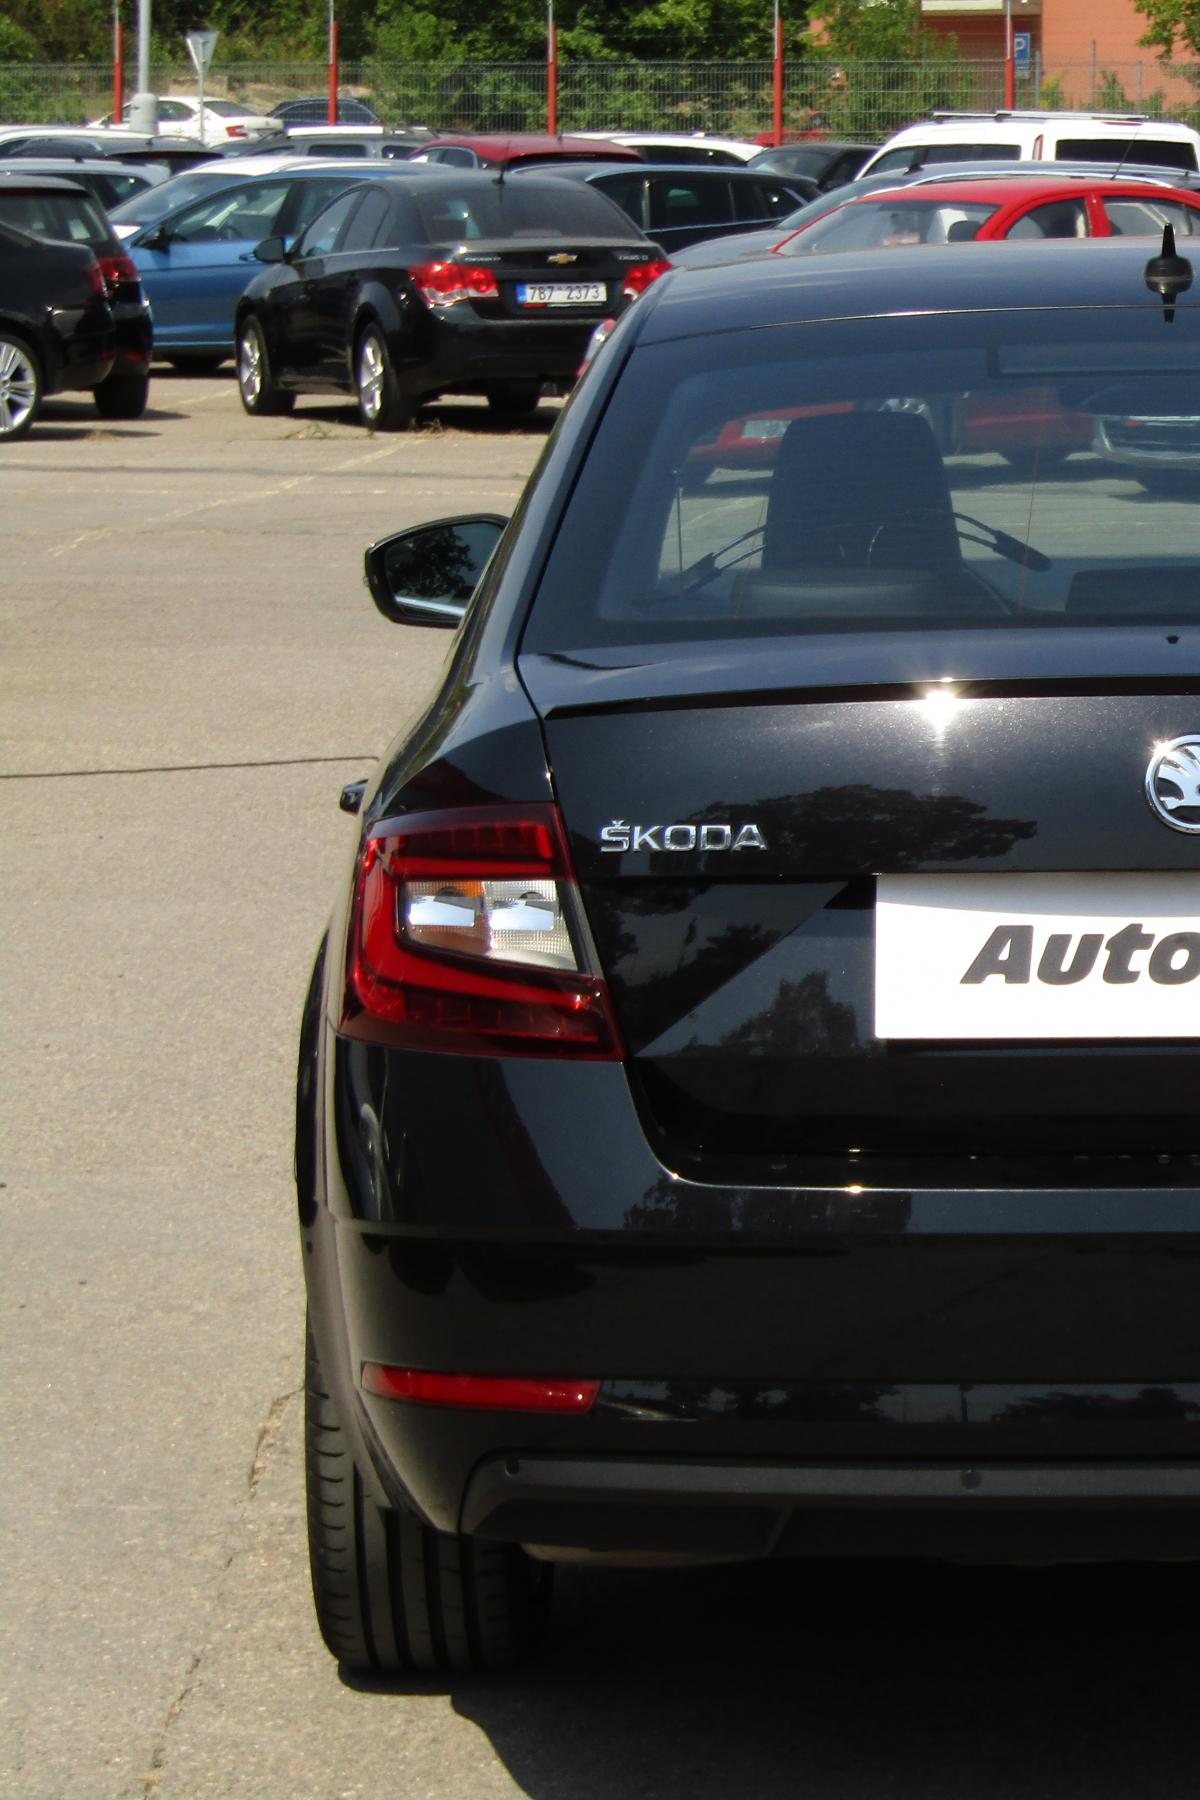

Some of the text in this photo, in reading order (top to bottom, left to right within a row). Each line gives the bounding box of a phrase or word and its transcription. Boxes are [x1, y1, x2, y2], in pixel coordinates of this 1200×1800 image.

[529, 285, 600, 301] 7B7 2373
[600, 820, 768, 852] ŠKODA
